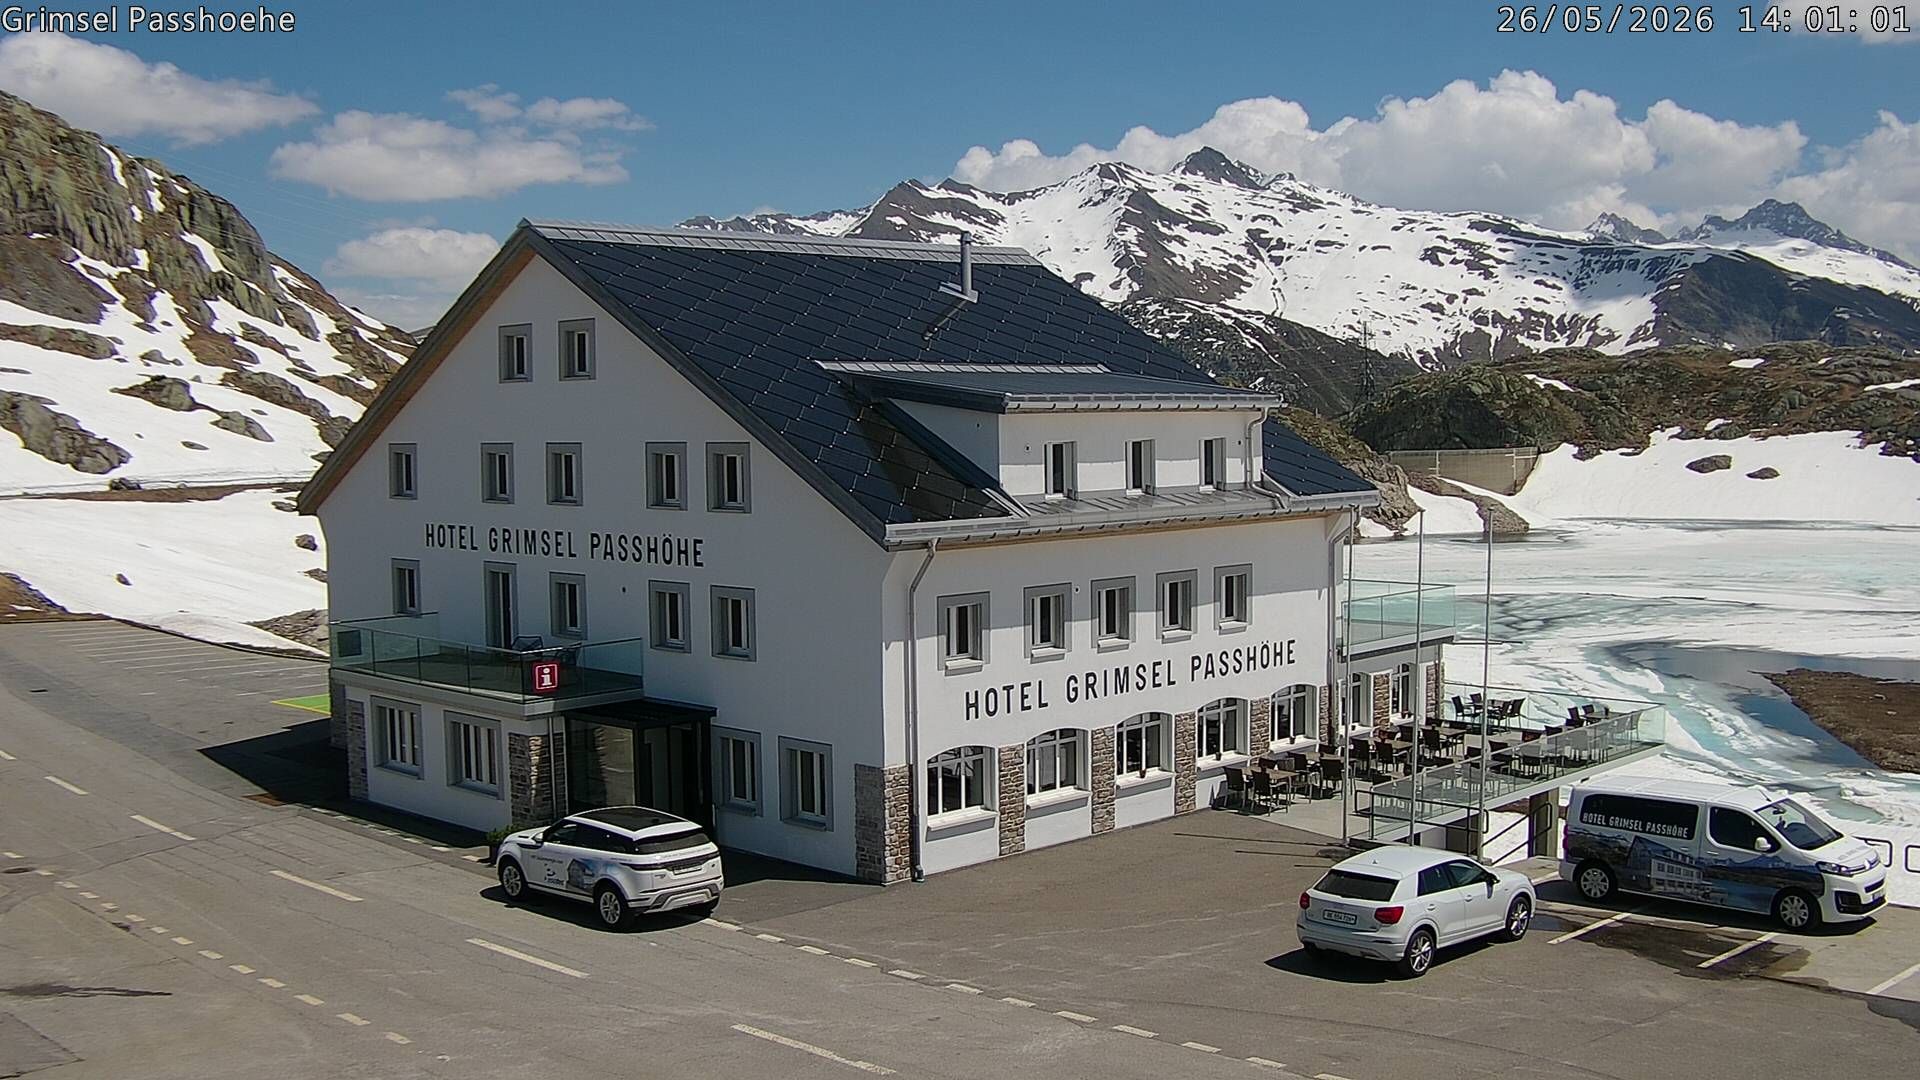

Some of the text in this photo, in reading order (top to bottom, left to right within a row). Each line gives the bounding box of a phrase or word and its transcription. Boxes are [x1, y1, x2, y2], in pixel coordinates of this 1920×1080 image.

[425, 523, 705, 567] HOTEL GRIMSEL PASSHÖHE
[965, 639, 1296, 721] HOTEL GRIMSEL PASSHÖHE
[1583, 812, 1688, 838] HOTEL GRIMSEL PASSHÖHE
